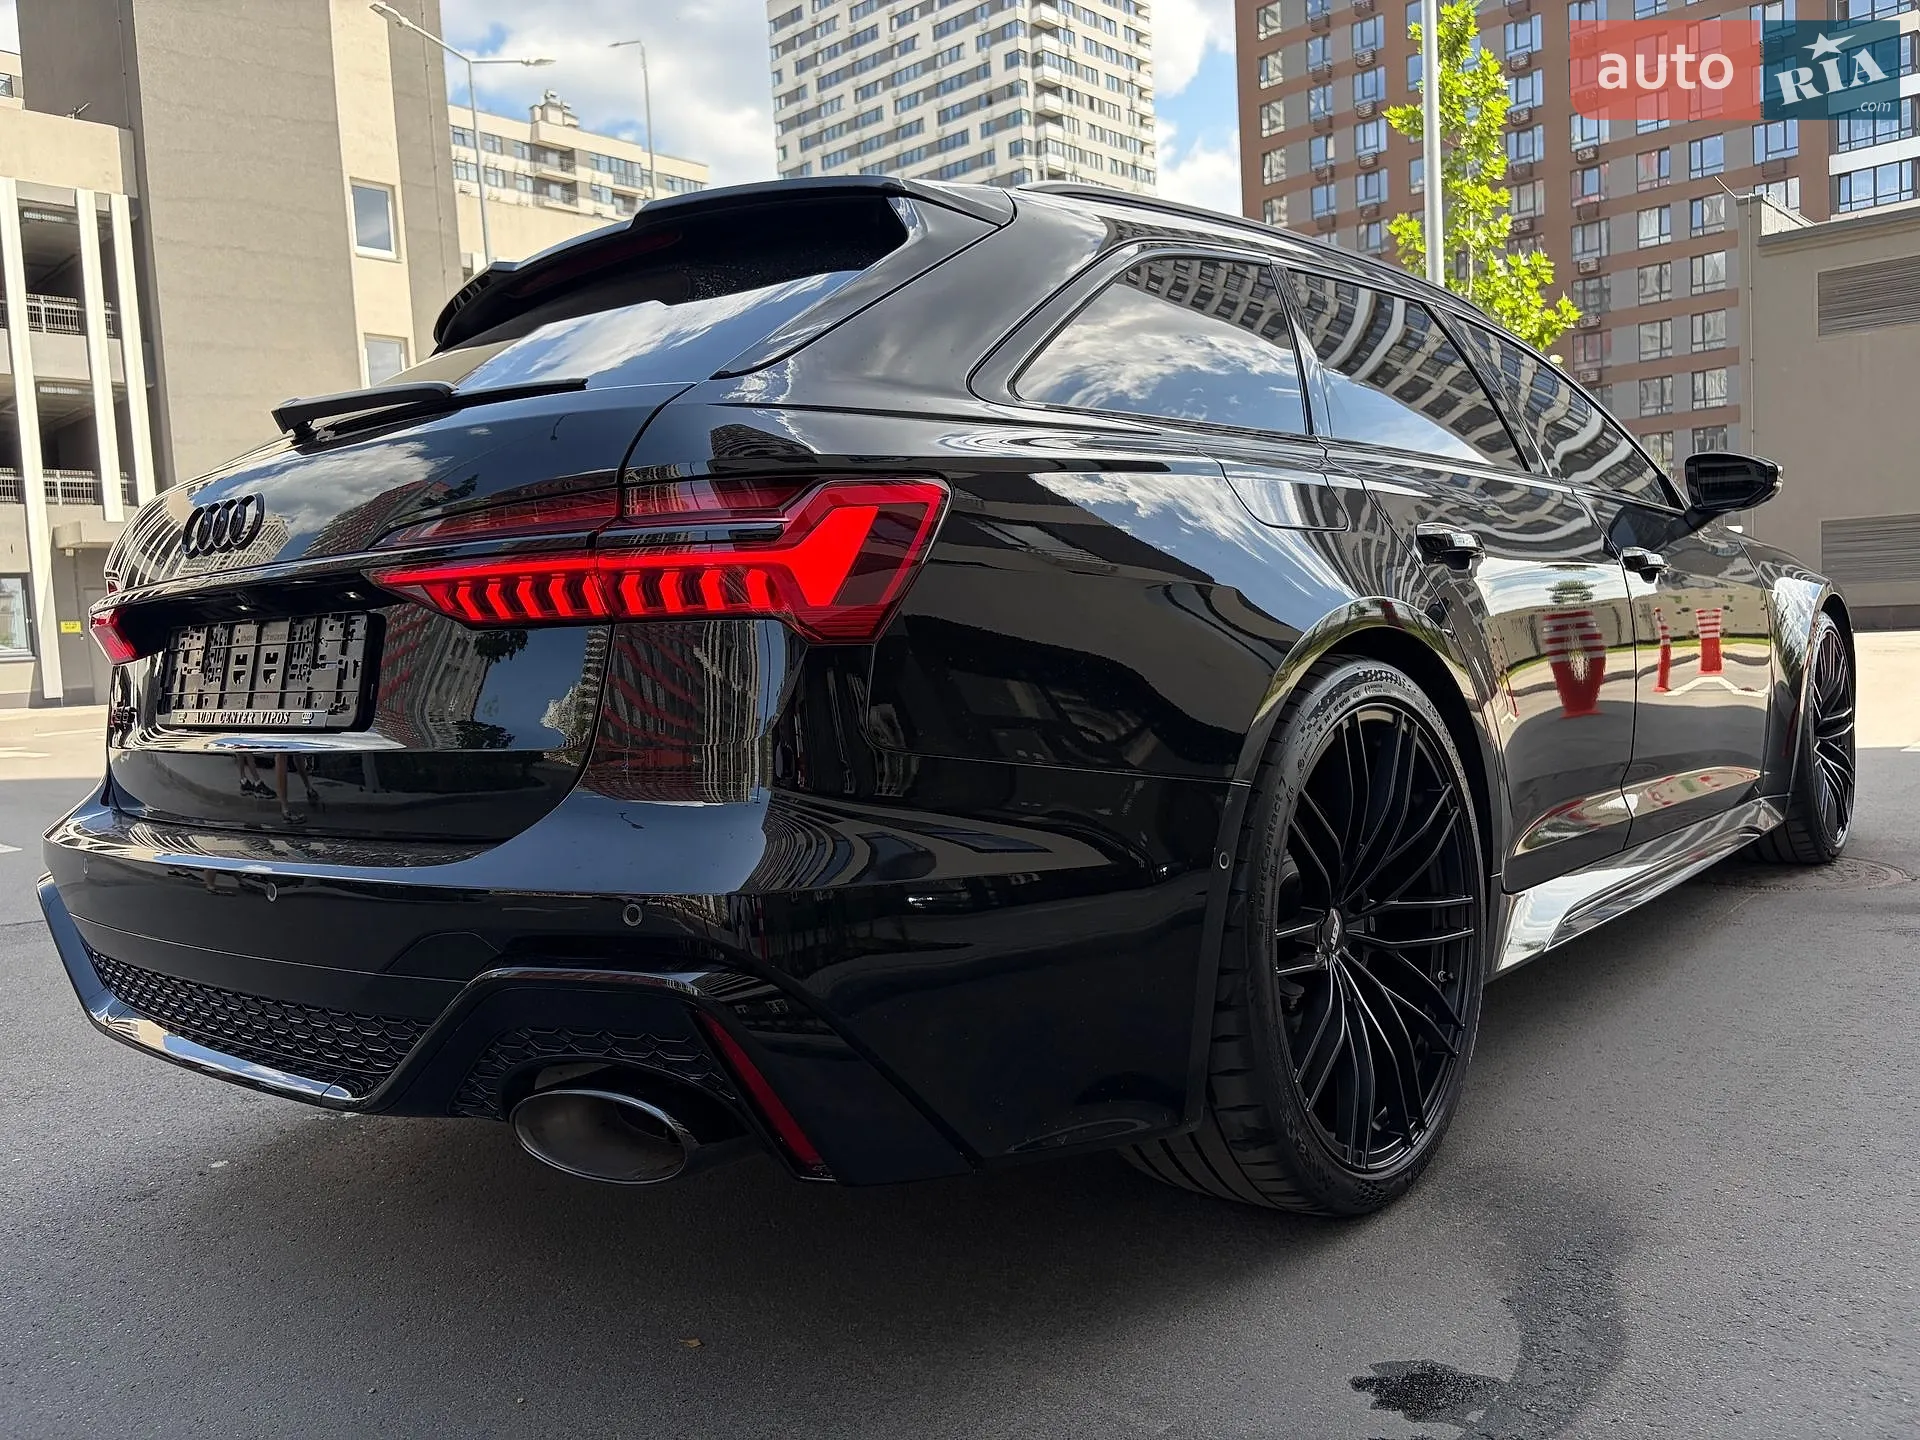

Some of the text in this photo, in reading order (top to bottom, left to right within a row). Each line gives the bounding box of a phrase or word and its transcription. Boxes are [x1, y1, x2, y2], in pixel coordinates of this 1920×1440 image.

[195, 711, 290, 724] AUDI CENTER VIPOS
